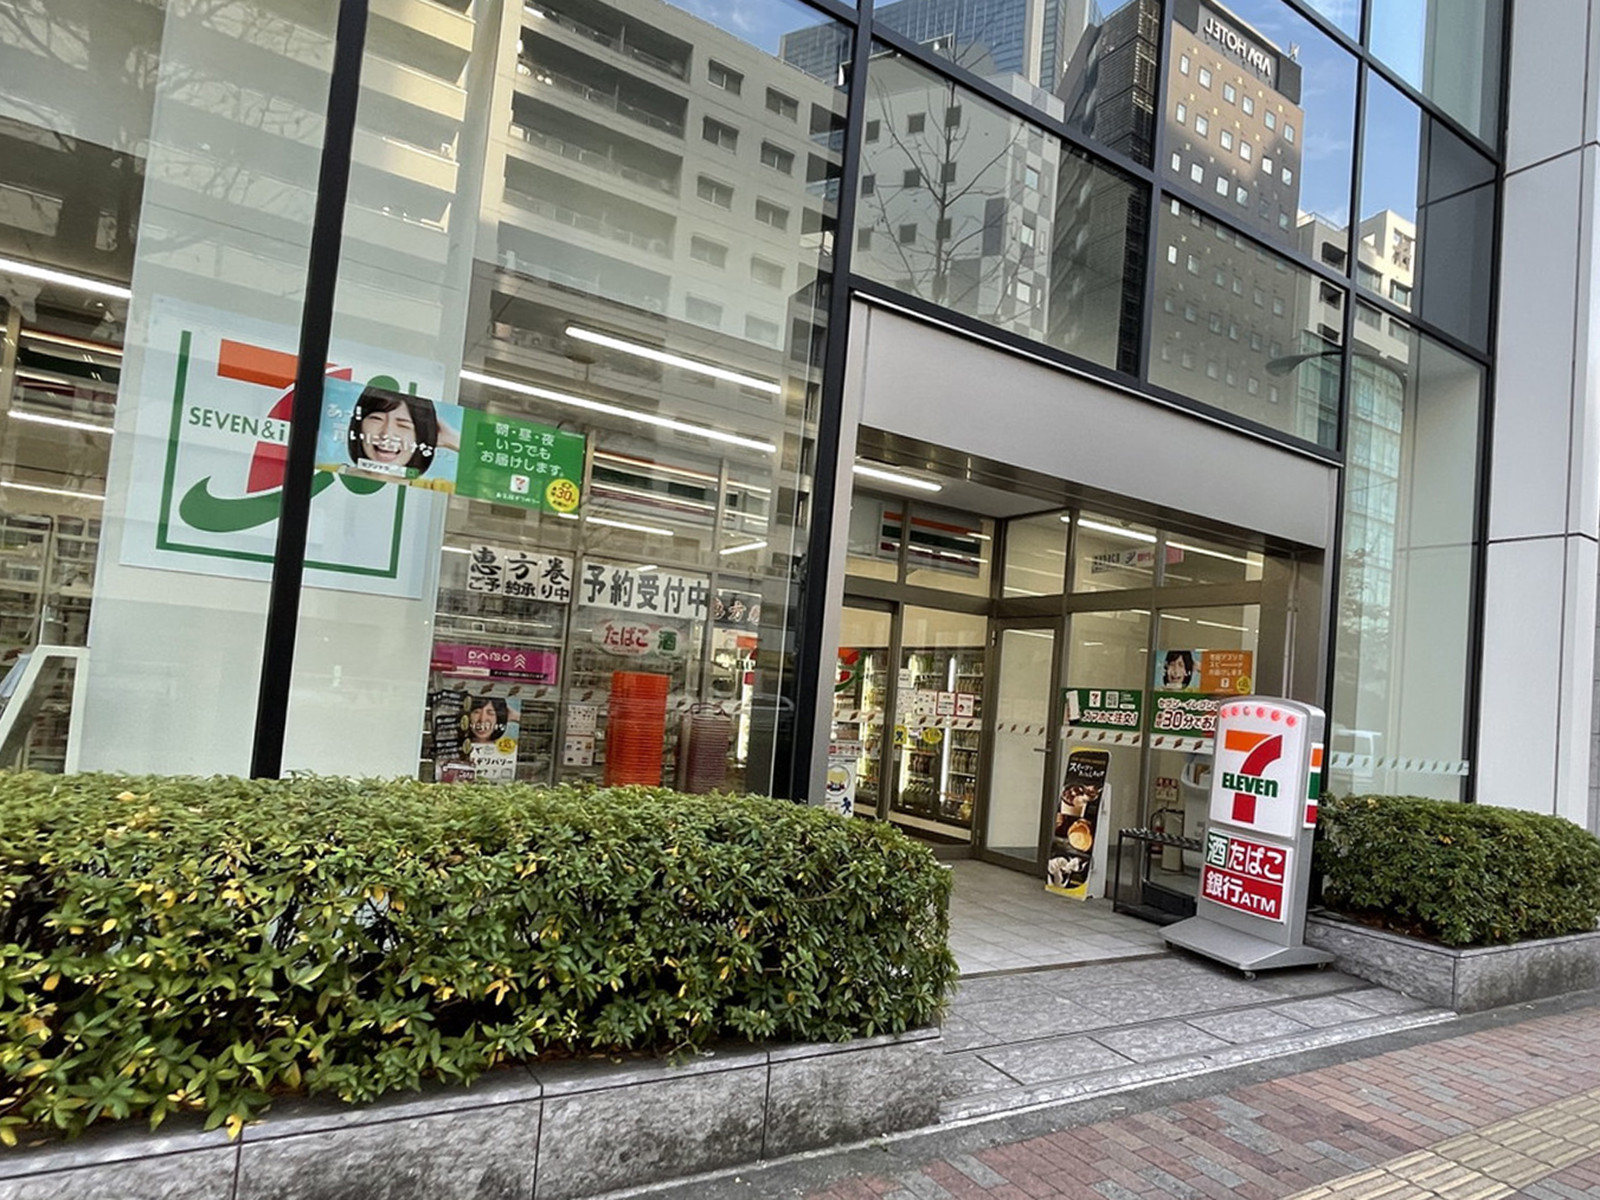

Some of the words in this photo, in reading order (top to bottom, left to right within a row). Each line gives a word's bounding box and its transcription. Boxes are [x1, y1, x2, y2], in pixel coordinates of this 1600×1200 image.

[480, 450, 564, 477] お届けします。
[496, 437, 551, 460] いつでも
[470, 547, 570, 585] 恵方巻
[583, 564, 709, 617] 予約受付中
[603, 624, 649, 648] たばこ
[657, 630, 678, 651] 酒
[1206, 835, 1227, 869] 酒
[1228, 841, 1284, 881] たばこ
[1205, 871, 1276, 914] 銀行ATM
